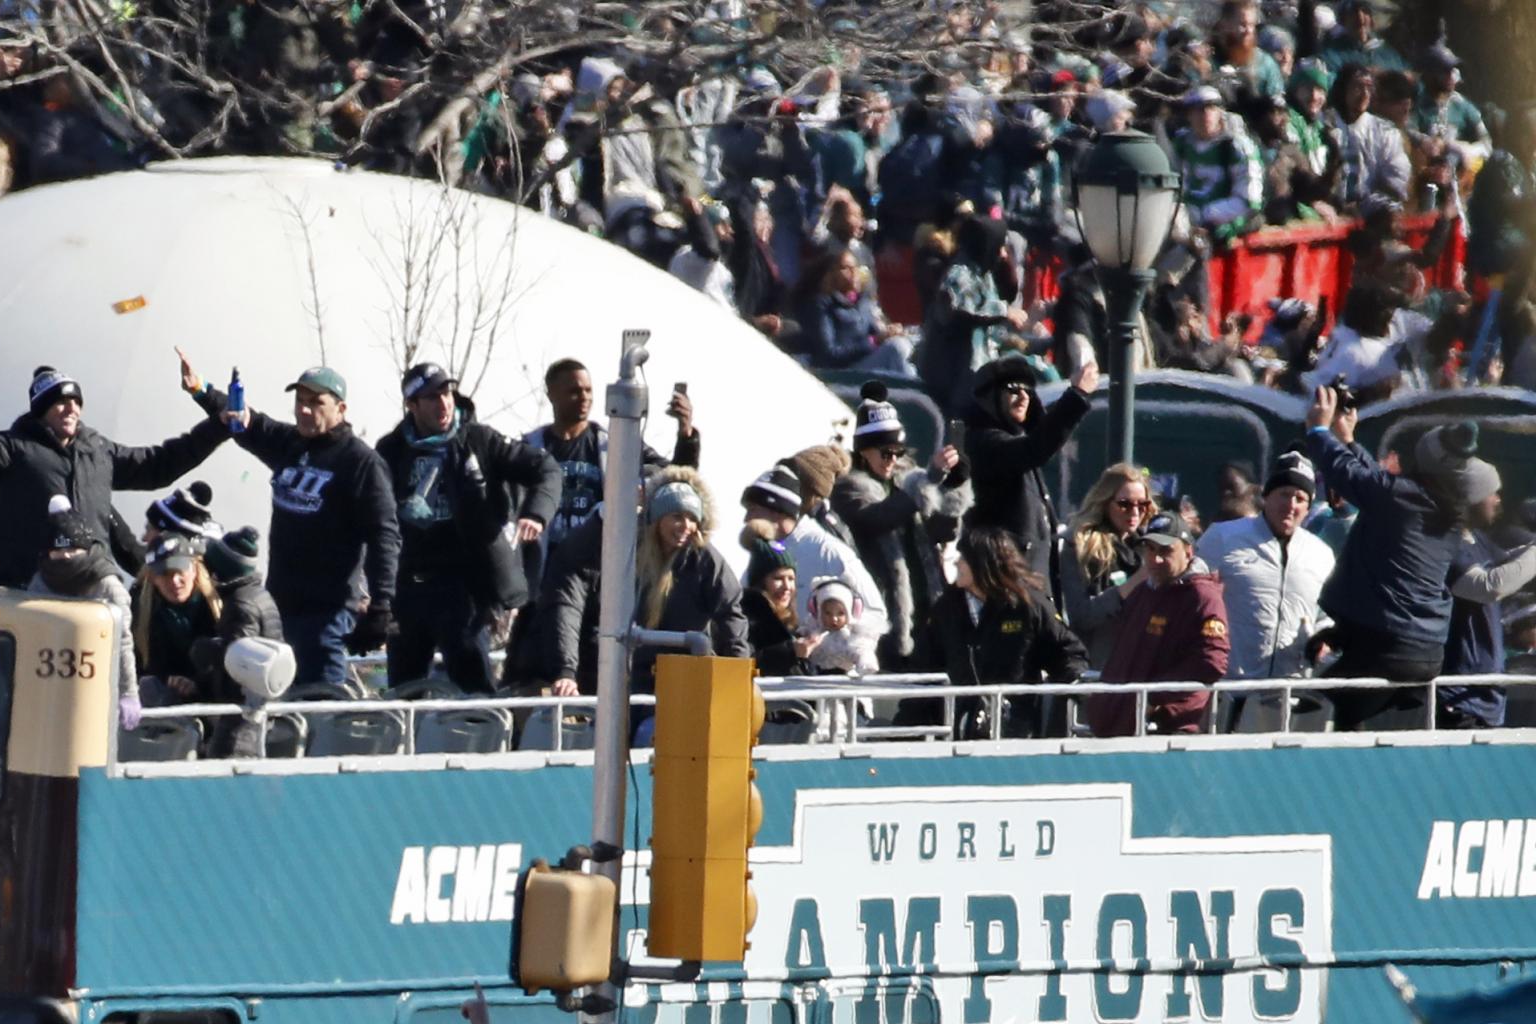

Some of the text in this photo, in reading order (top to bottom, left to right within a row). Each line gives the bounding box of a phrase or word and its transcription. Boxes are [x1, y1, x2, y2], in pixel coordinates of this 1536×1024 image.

[35, 648, 95, 679] 335
[866, 819, 1056, 863] WORLD
[390, 843, 522, 924] ACME
